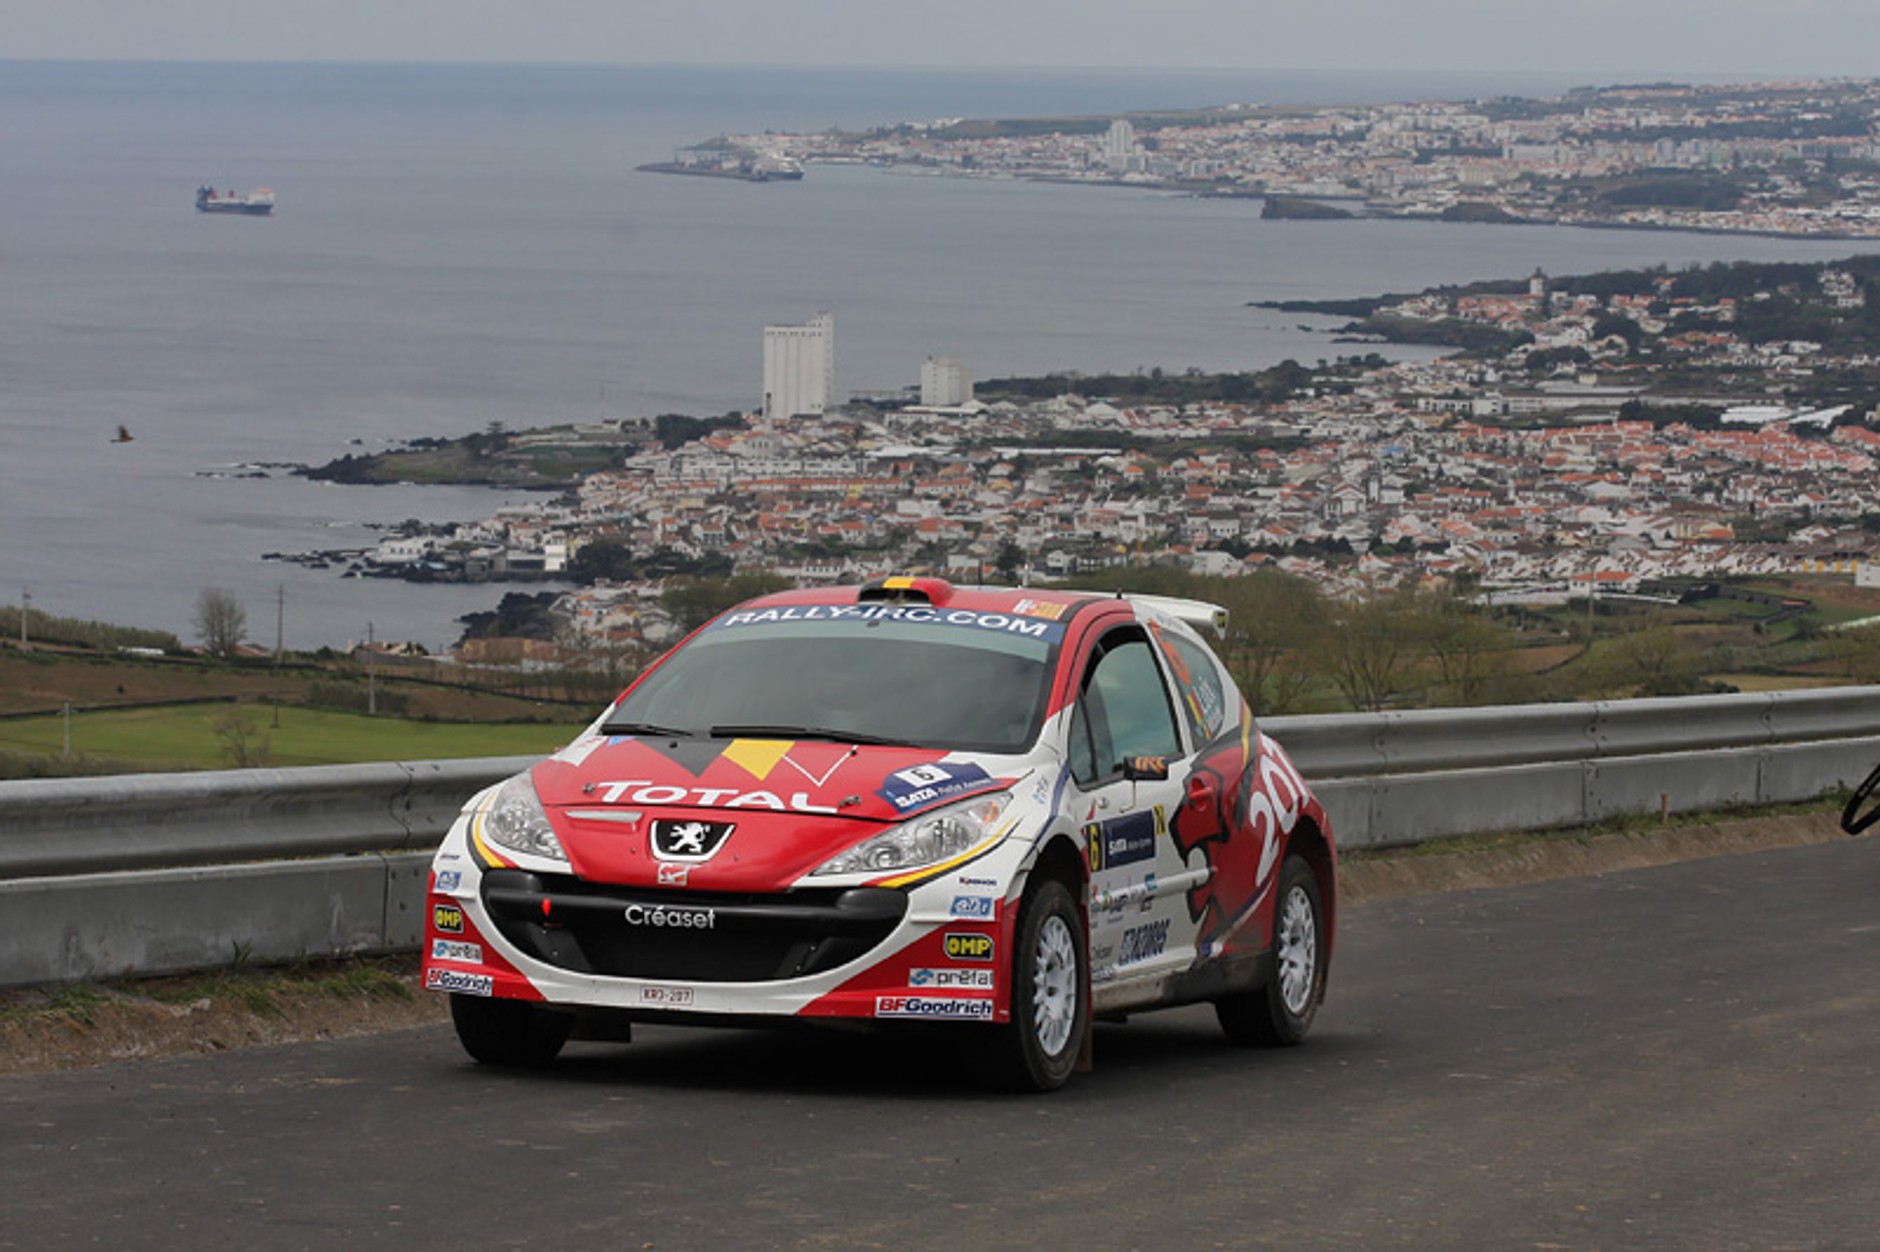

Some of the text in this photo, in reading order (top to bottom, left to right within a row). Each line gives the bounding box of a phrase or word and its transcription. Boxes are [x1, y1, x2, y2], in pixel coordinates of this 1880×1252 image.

[724, 605, 1048, 637] RALLY-IRC.COM
[911, 768, 935, 781] 6
[596, 780, 838, 814] TOTAL
[895, 787, 938, 808] SATA
[436, 909, 462, 928] OMP
[624, 904, 716, 929] Créaset
[947, 937, 991, 955] OMP
[428, 969, 492, 991] BFGoodrich
[879, 998, 992, 1015] BFGoodrich
